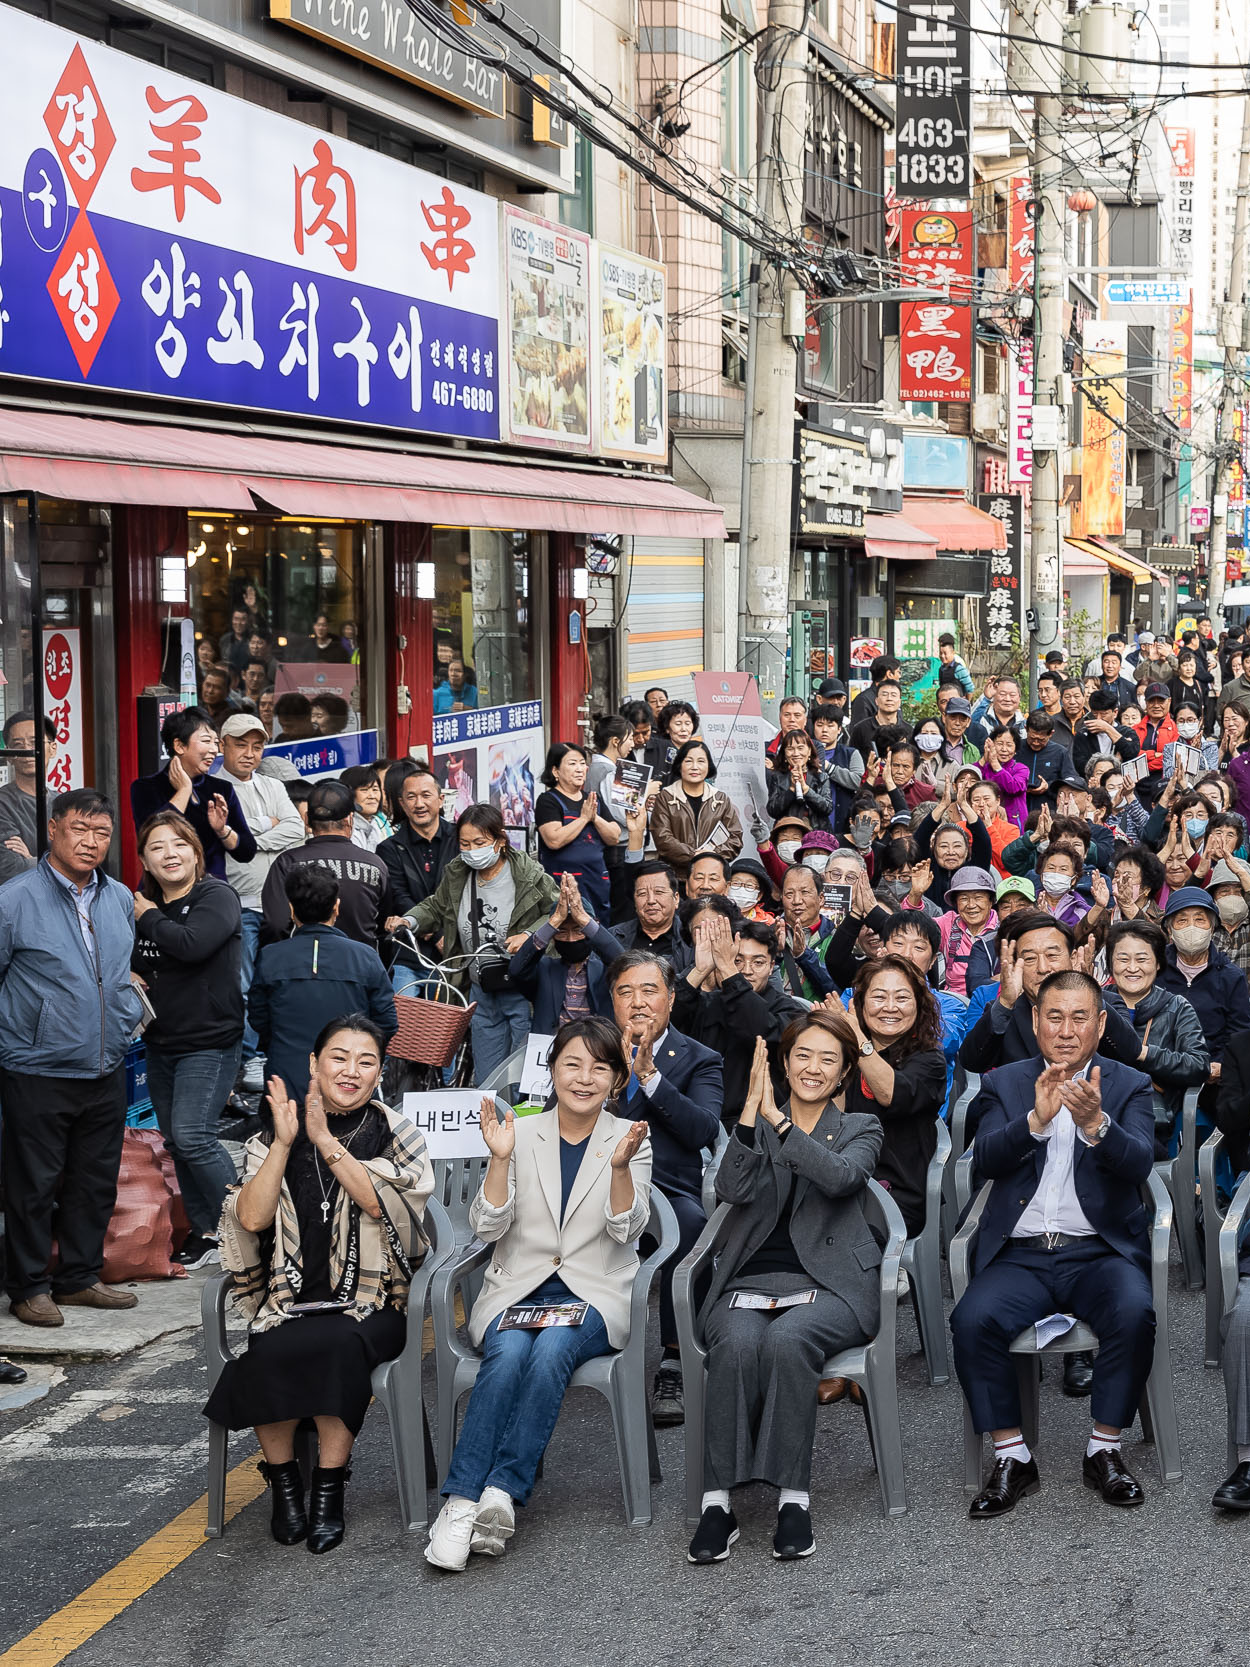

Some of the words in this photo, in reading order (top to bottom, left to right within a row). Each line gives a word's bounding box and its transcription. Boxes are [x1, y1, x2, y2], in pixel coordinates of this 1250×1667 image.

[463, 54, 499, 101] Bar
[904, 66, 963, 97] HOF
[898, 118, 967, 148] 463-
[899, 154, 965, 184] 1833
[131, 85, 476, 293] 羊肉串
[511, 226, 527, 250] KBS
[609, 264, 619, 284] SBS
[141, 242, 423, 412] 양꼬치구이
[432, 380, 494, 414] 467-6880
